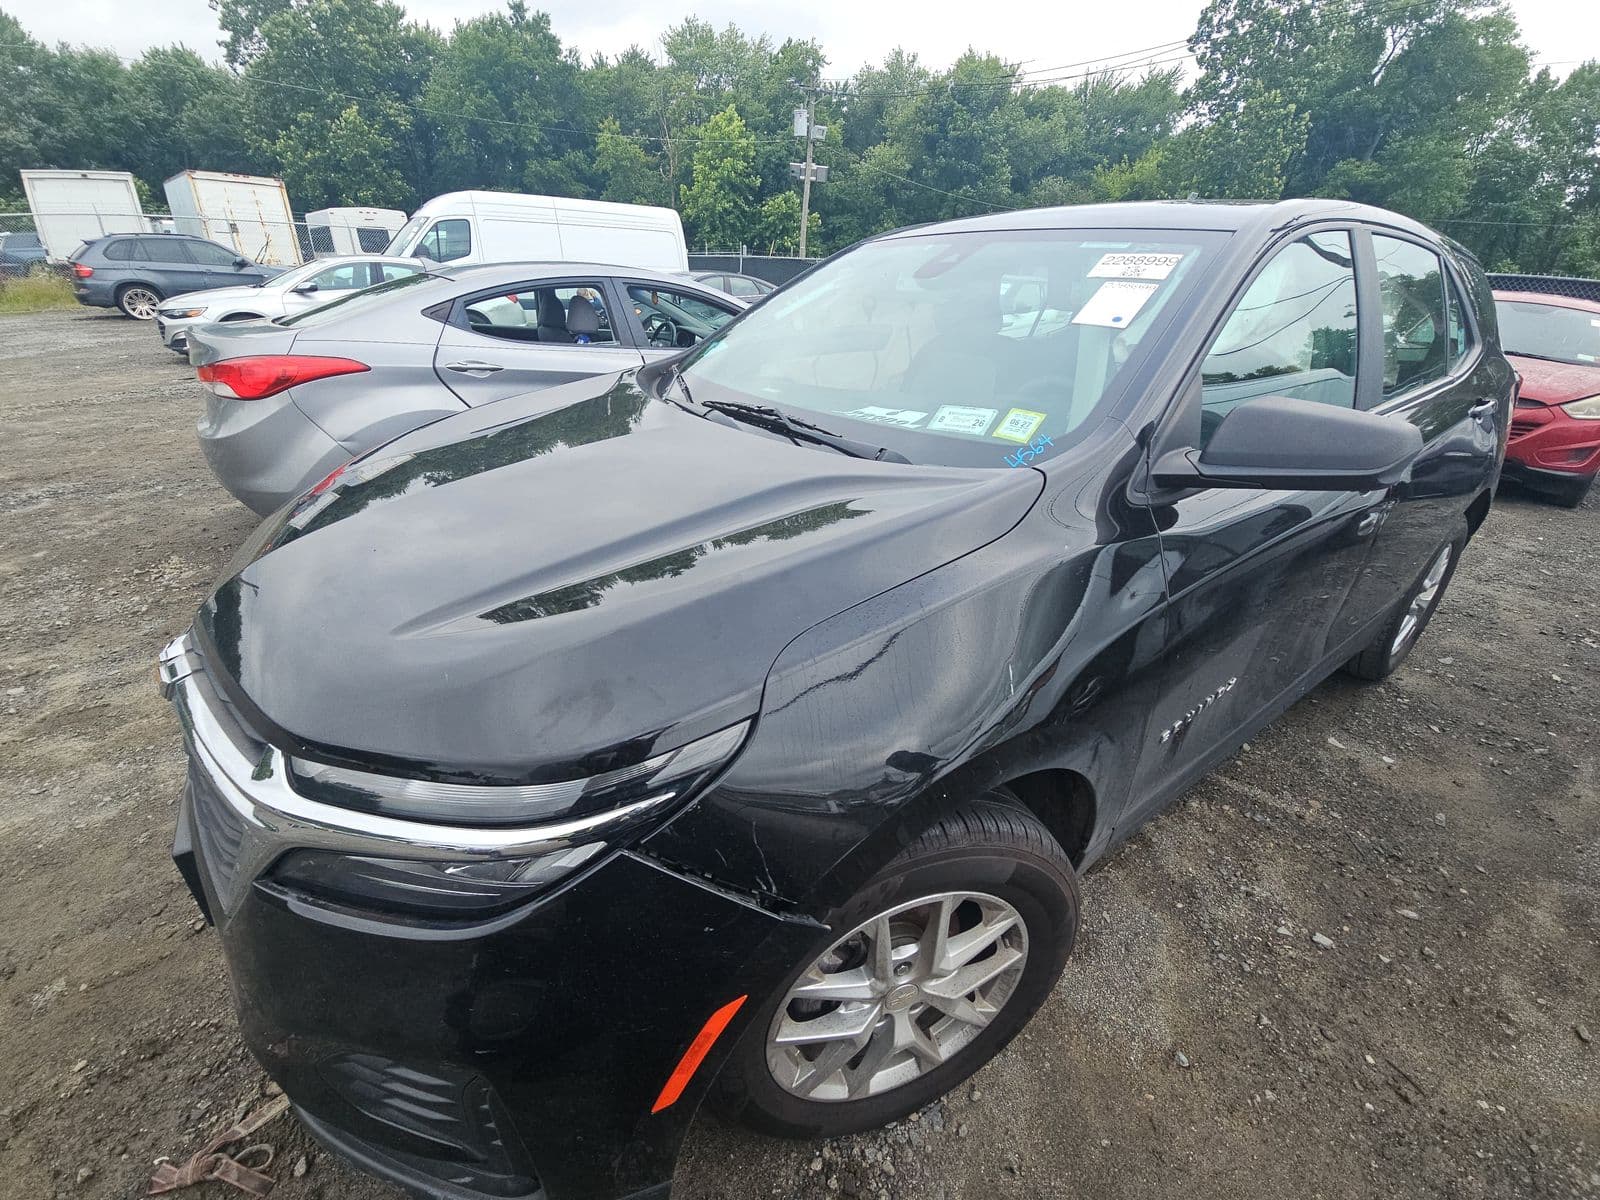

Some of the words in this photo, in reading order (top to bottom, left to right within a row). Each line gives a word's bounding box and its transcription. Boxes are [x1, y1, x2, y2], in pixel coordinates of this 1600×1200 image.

[1101, 255, 1180, 267] 2288999
[972, 419, 986, 427] 26
[1003, 433, 1054, 468] 4564
